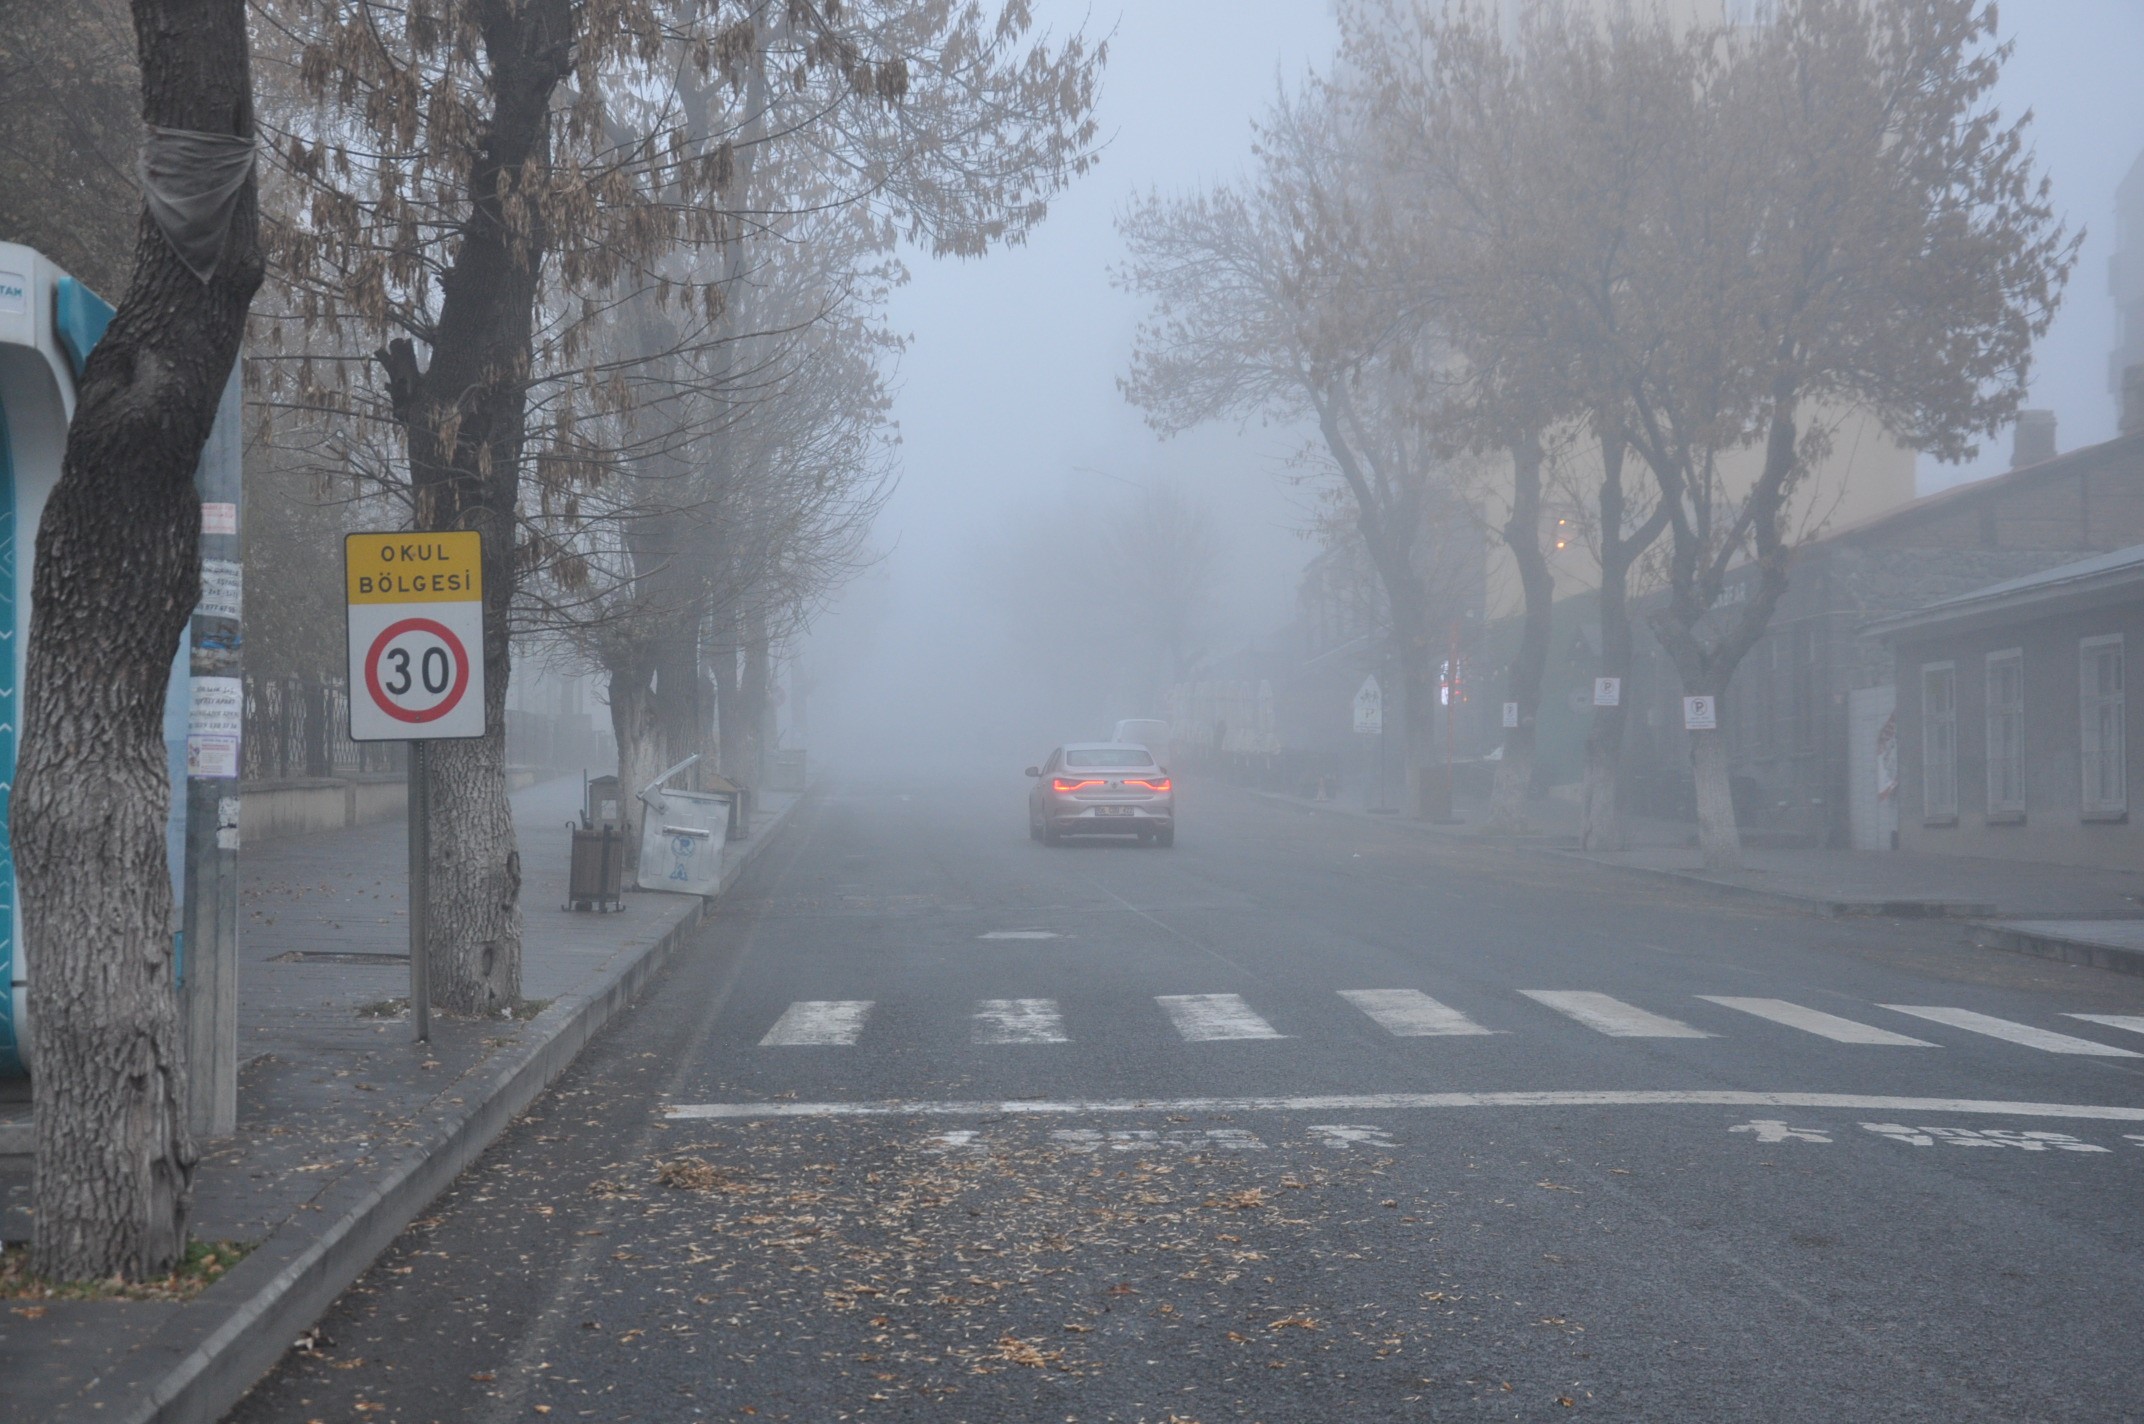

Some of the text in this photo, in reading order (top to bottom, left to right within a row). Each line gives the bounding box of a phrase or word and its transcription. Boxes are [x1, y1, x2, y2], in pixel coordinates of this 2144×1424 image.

[381, 544, 450, 562] OKUL
[359, 569, 471, 594] BÖLGESİ
[386, 646, 450, 695] 30
